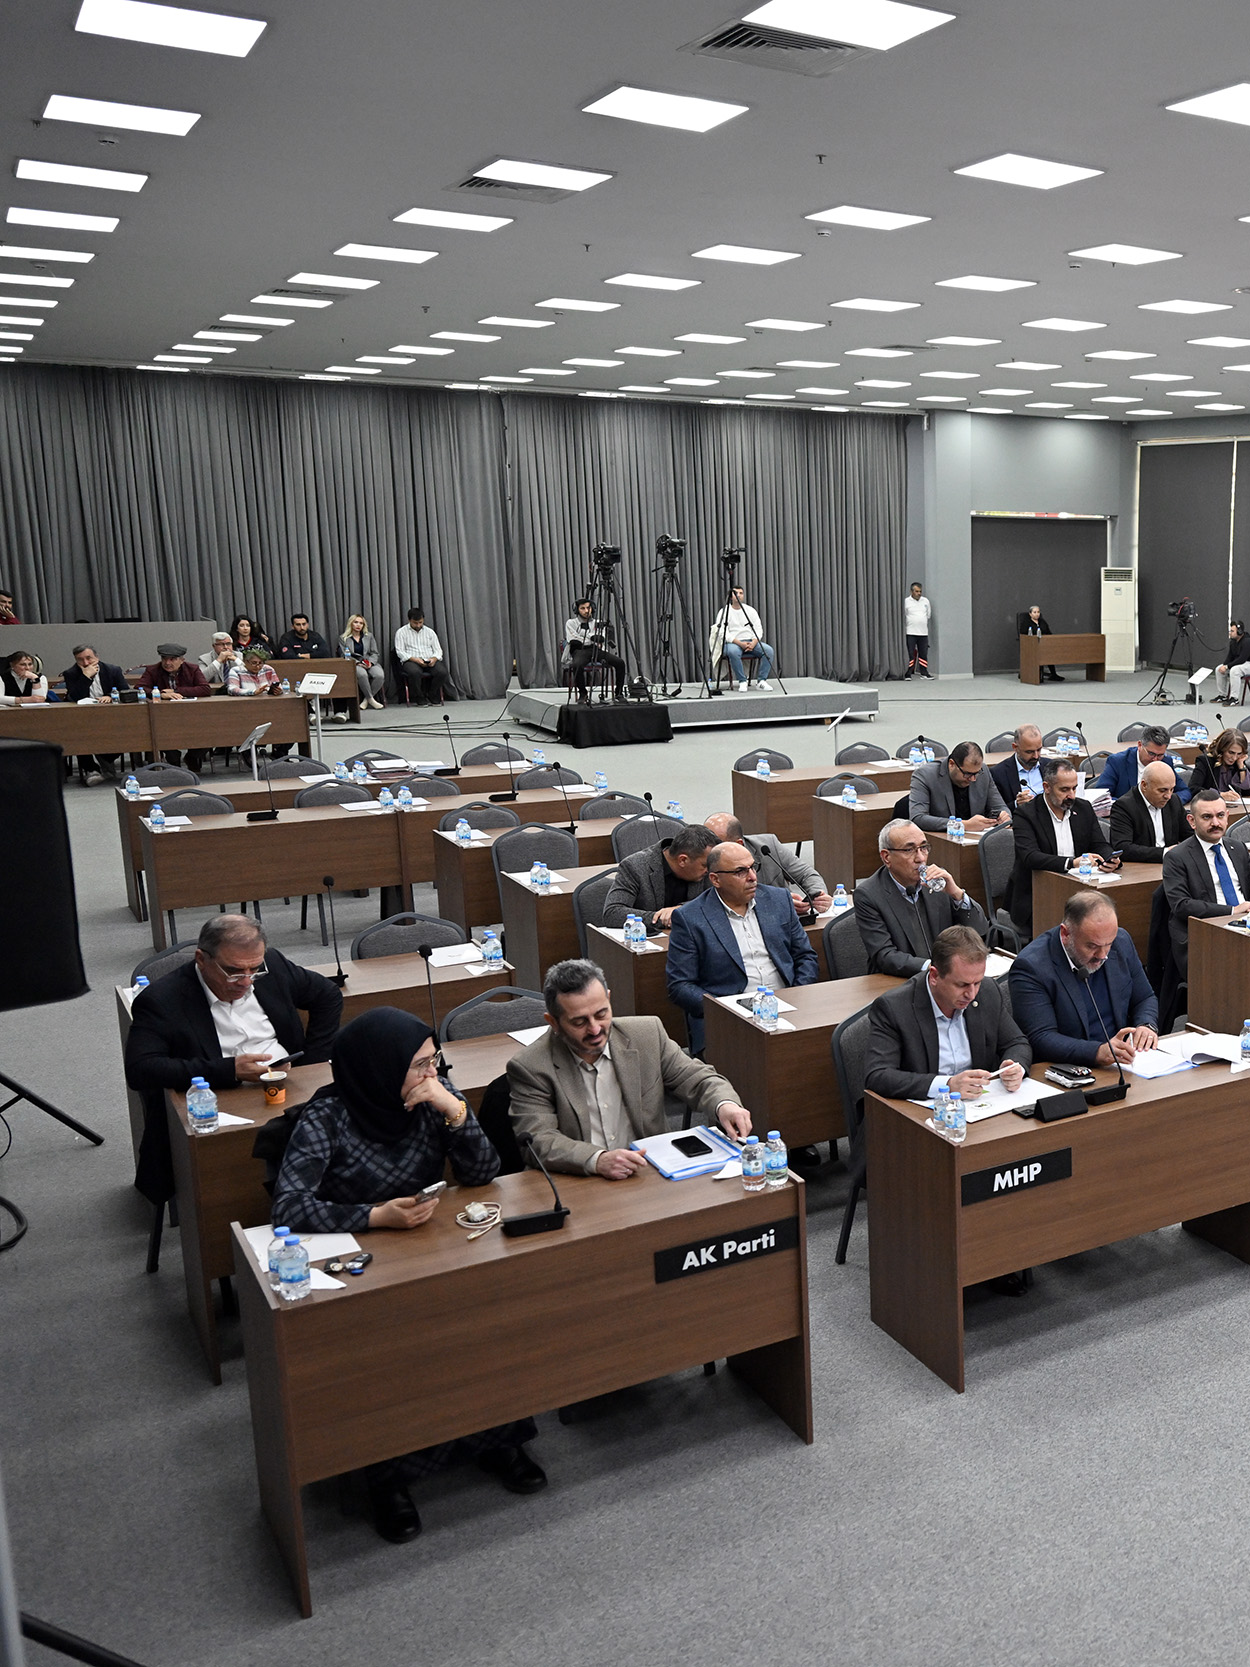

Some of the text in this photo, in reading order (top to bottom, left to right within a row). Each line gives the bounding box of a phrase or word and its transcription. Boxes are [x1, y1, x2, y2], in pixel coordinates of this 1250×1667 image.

[993, 1162, 1042, 1192] MHP
[682, 1228, 776, 1271] AK Parti
